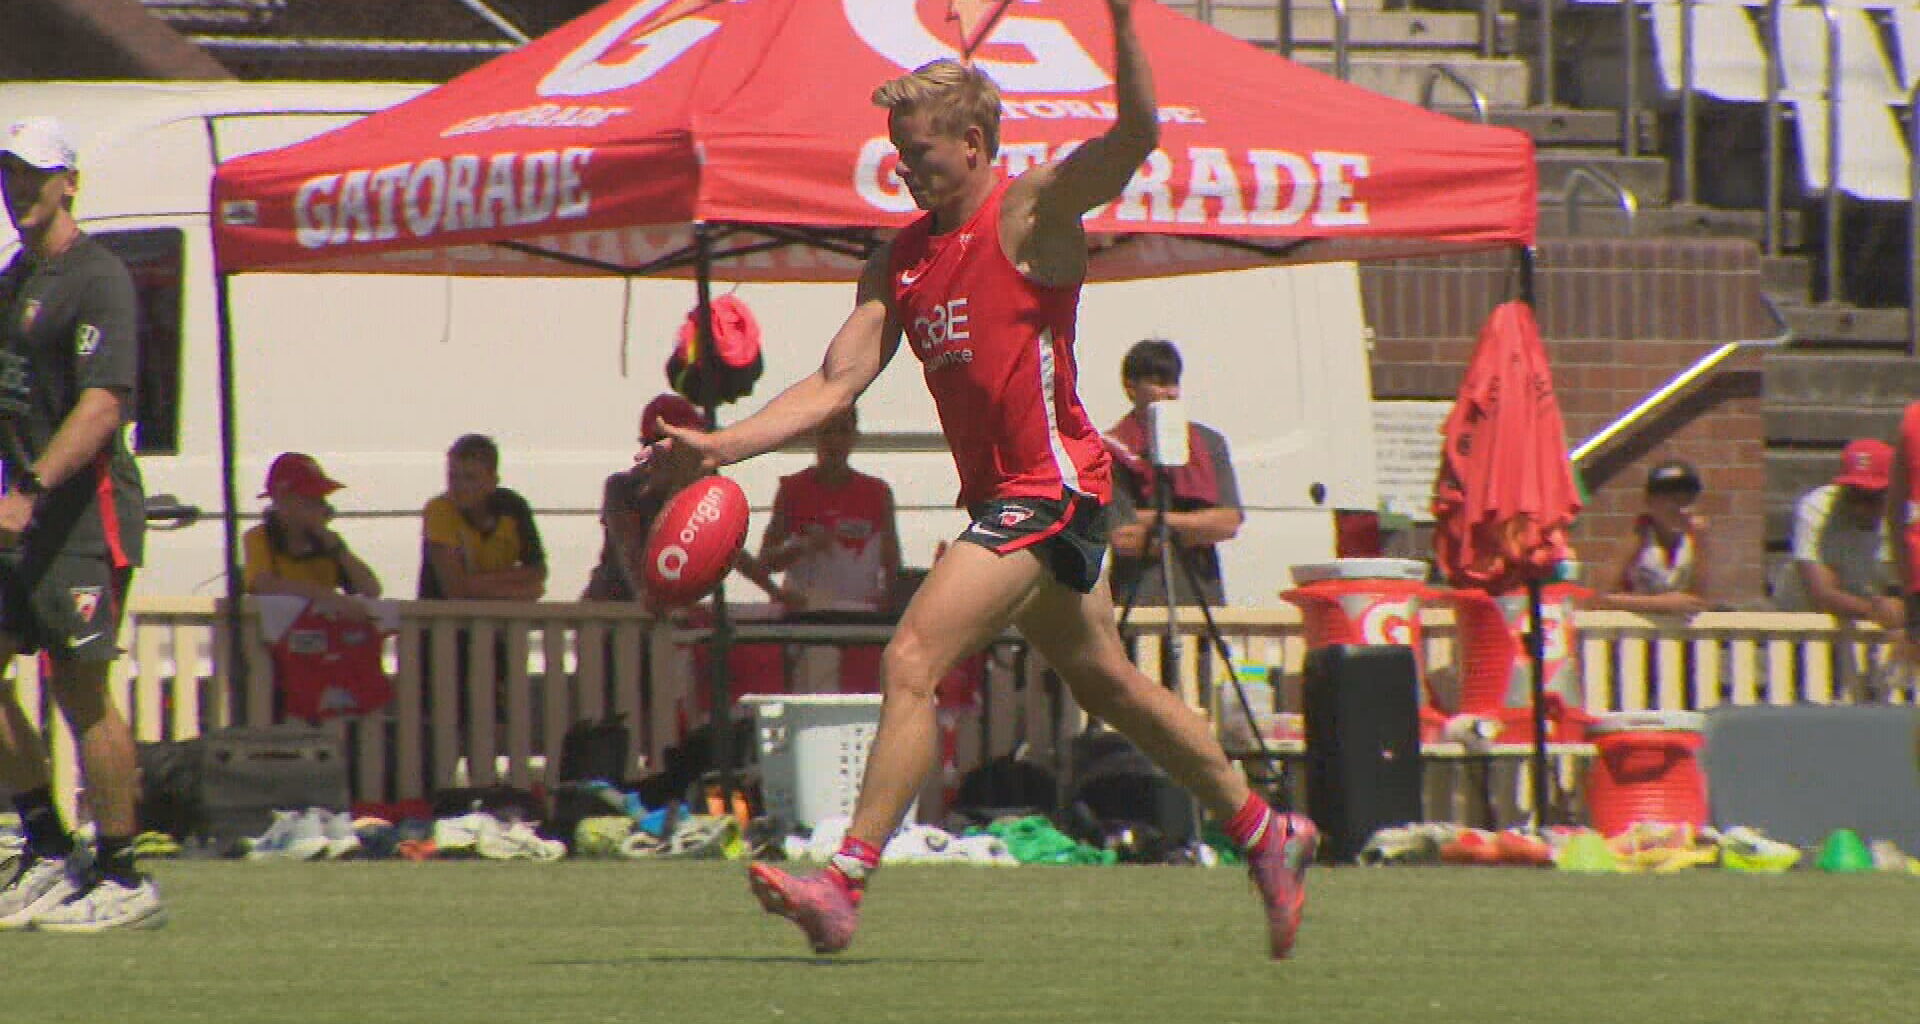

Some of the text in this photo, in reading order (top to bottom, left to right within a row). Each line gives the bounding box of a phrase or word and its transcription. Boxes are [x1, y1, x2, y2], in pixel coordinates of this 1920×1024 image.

[294, 147, 594, 250] GATORADE
[853, 142, 1371, 227] GTRADE
[679, 486, 725, 543] origin
